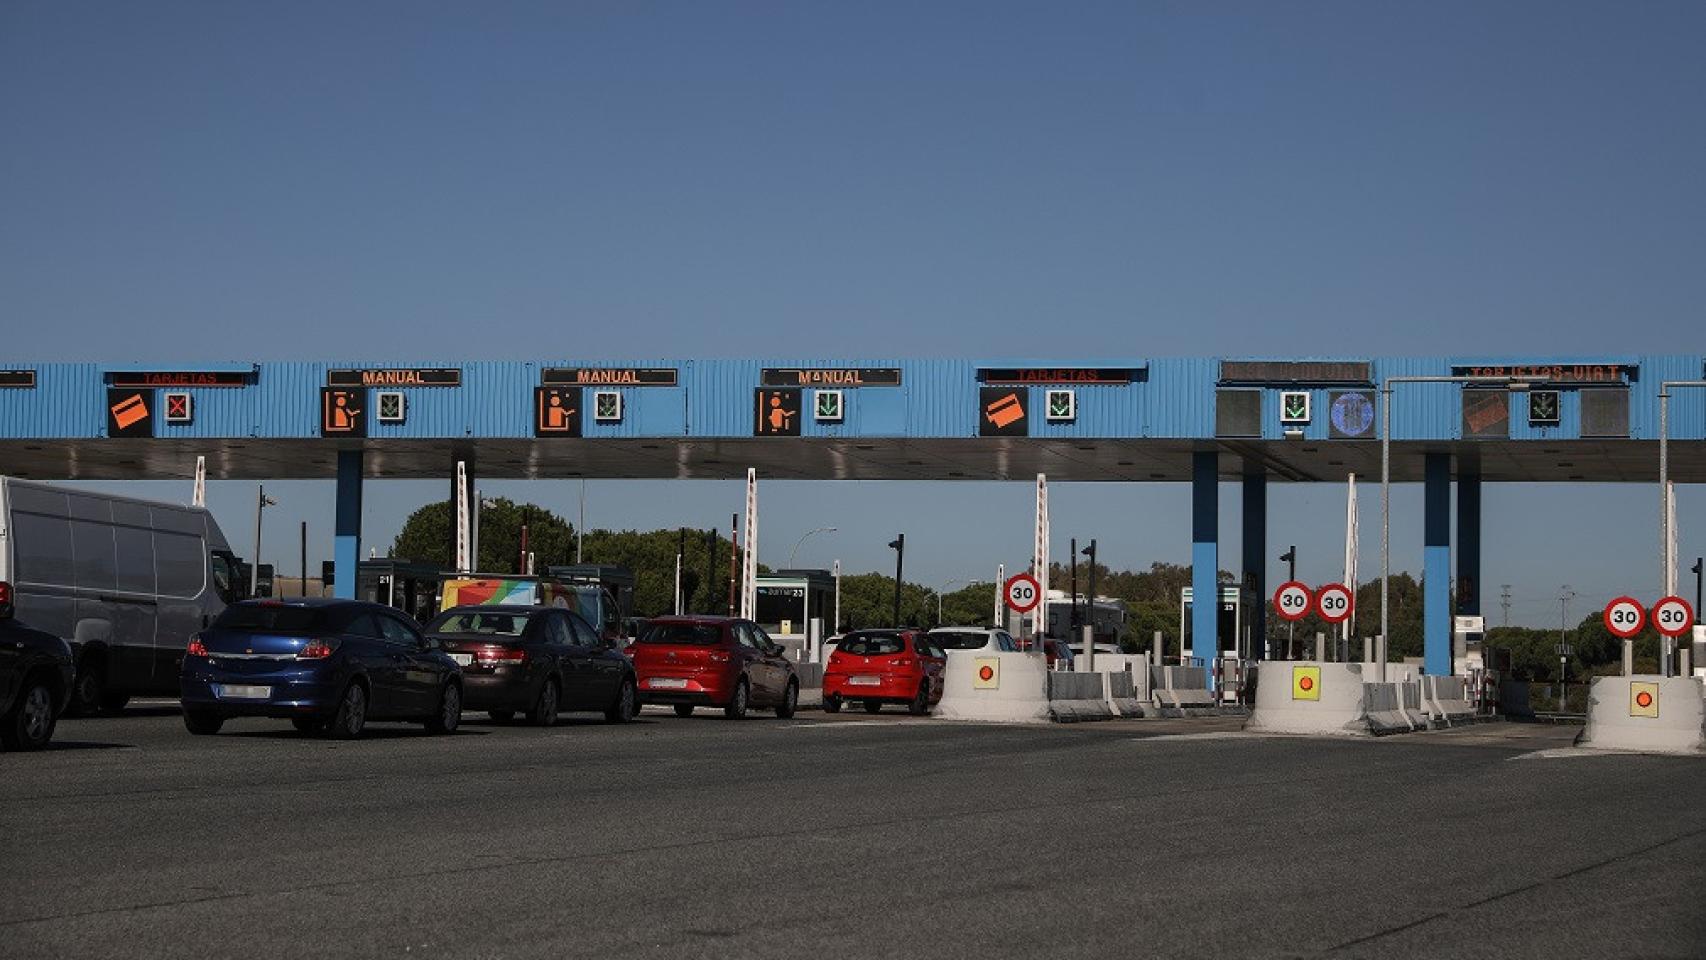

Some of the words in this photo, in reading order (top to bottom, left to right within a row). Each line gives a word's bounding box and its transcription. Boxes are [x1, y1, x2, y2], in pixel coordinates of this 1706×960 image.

[144, 373, 217, 384] TARJETAS
[362, 371, 424, 384] MANUAL
[577, 370, 640, 383] MANUAL
[798, 370, 863, 383] MANUAL
[1016, 370, 1098, 382] TARJETAS
[1012, 587, 1034, 600] 30
[1283, 594, 1305, 608] 30
[1324, 597, 1346, 610] 30
[1613, 610, 1637, 624] 30
[1660, 609, 1685, 624] 30
